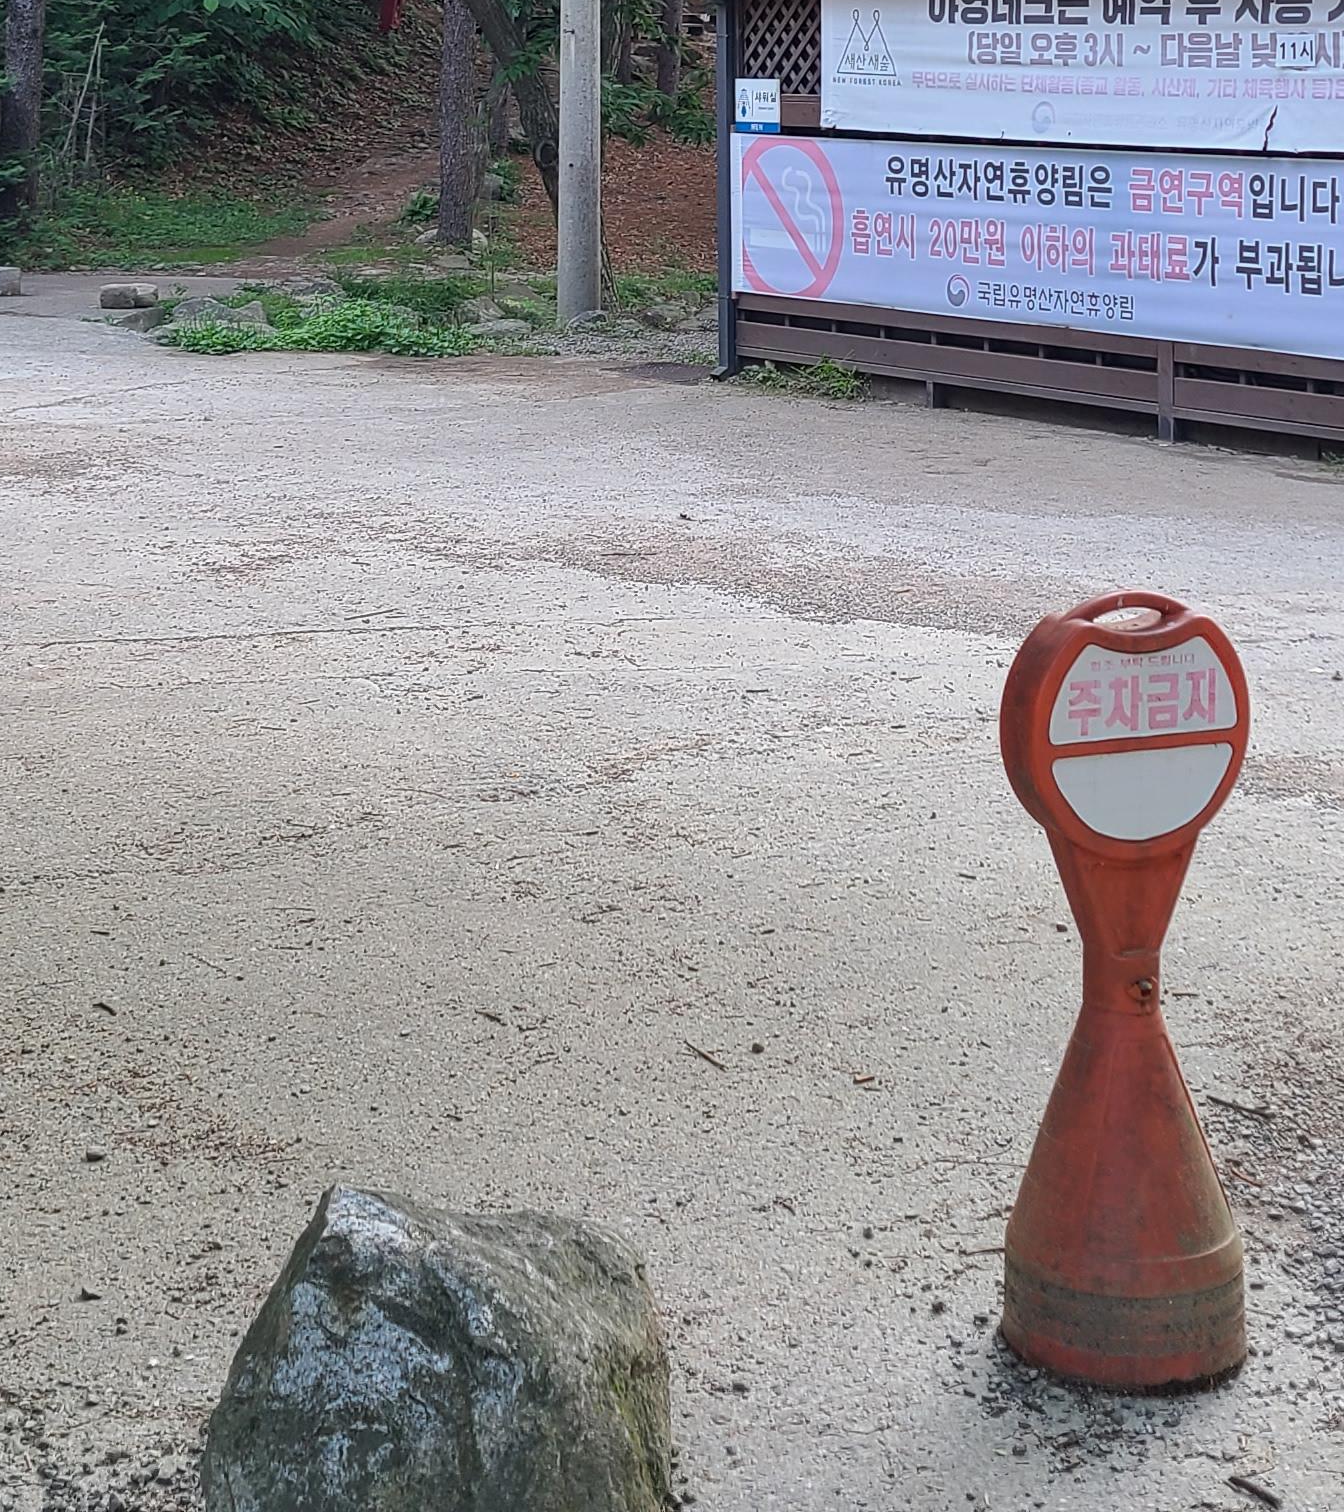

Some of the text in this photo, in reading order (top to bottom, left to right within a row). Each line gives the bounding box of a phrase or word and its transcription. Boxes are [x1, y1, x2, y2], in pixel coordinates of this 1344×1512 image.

[967, 30, 1022, 65] (당일
[1029, 32, 1077, 67] 오후
[1084, 33, 1124, 67] 3시
[1160, 32, 1242, 69] 다음날
[832, 76, 846, 84] NEW
[850, 77, 876, 85] FOREST
[912, 71, 961, 89] 무단으로
[965, 73, 1017, 92] 실시하는
[1208, 78, 1239, 99] 기타
[1242, 78, 1305, 100] 체육행사
[885, 156, 1340, 224] 유명산자연휴양림은 금연구역입니다
[851, 209, 916, 260] 흡연시
[929, 218, 1005, 267] 20만원
[1021, 224, 1095, 275] 이하의
[1109, 230, 1220, 287] 과태료가
[978, 281, 1134, 321] 국립유명산자연휴양림
[1067, 667, 1216, 736] 주차금지
